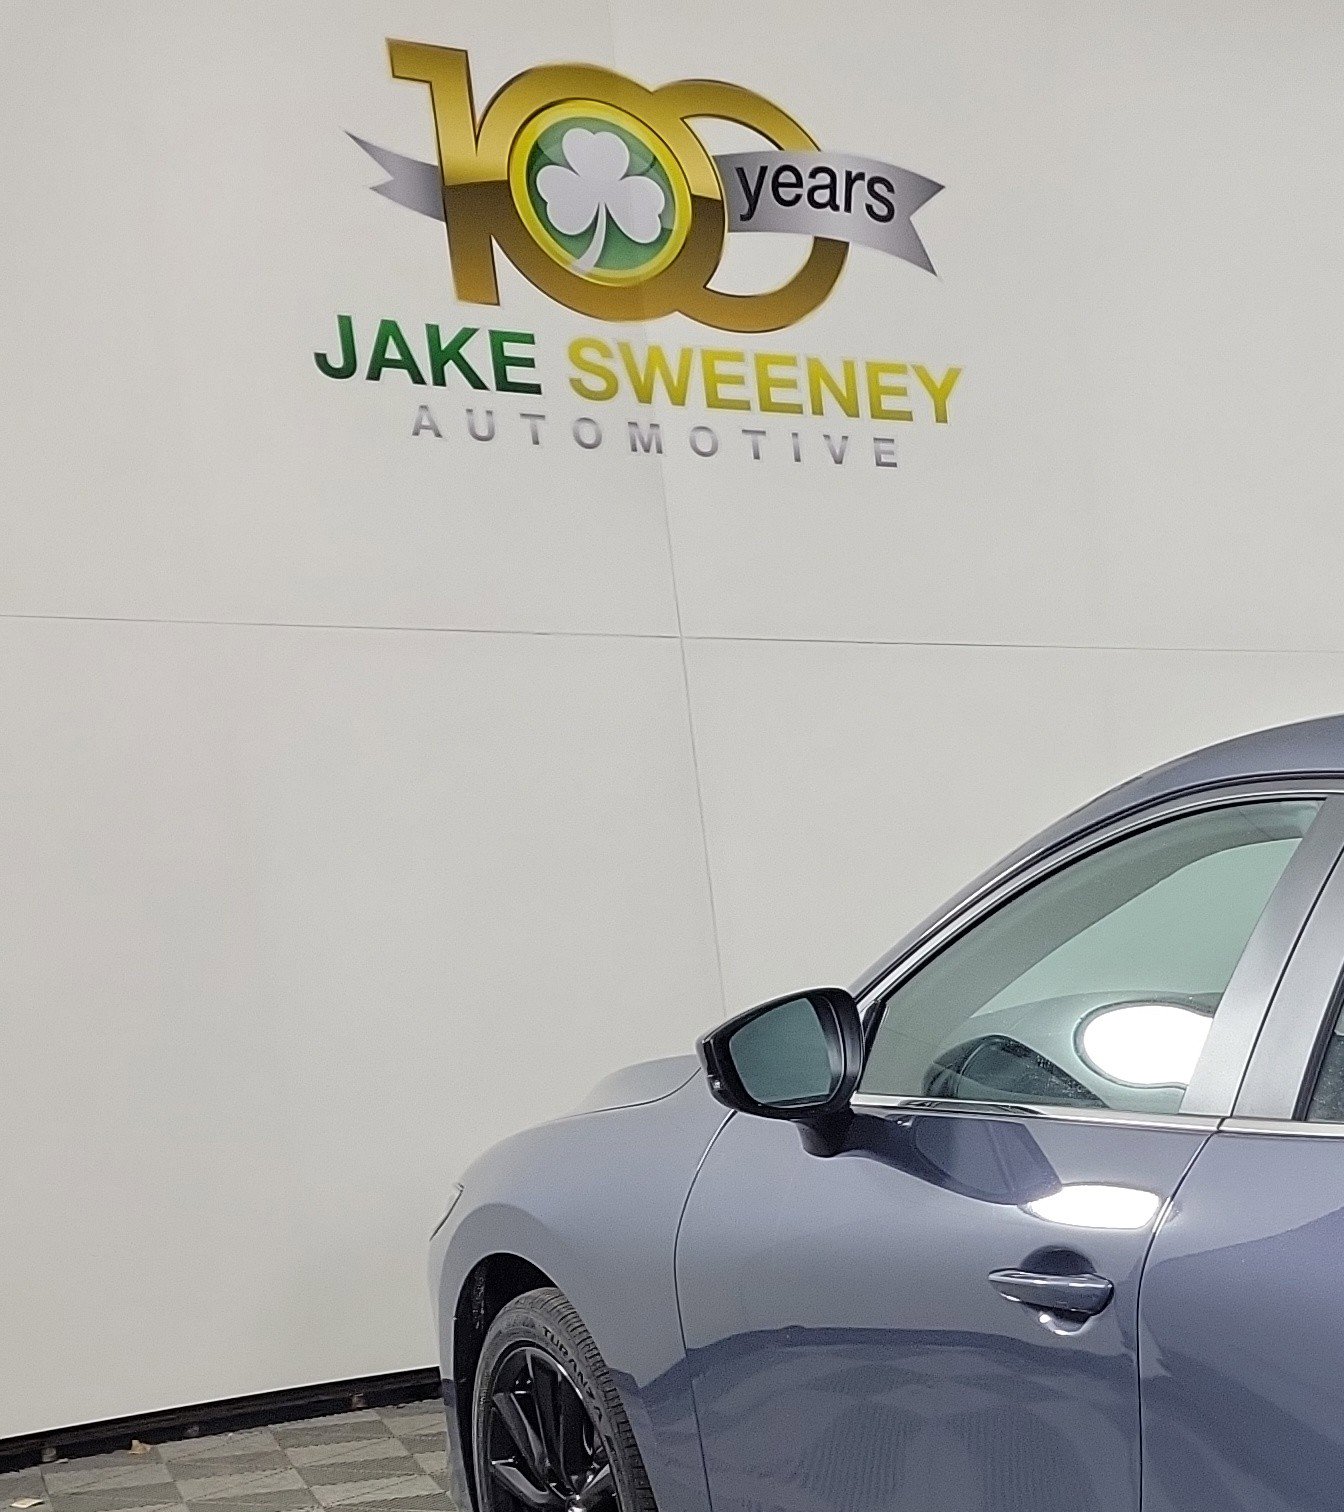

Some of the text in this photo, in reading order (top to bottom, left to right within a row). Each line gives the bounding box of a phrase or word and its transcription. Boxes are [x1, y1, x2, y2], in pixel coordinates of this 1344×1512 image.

[386, 37, 897, 333] 100 years
[314, 313, 964, 425] JAKE SWEENEY
[411, 404, 900, 468] AUTOMOTIVE
